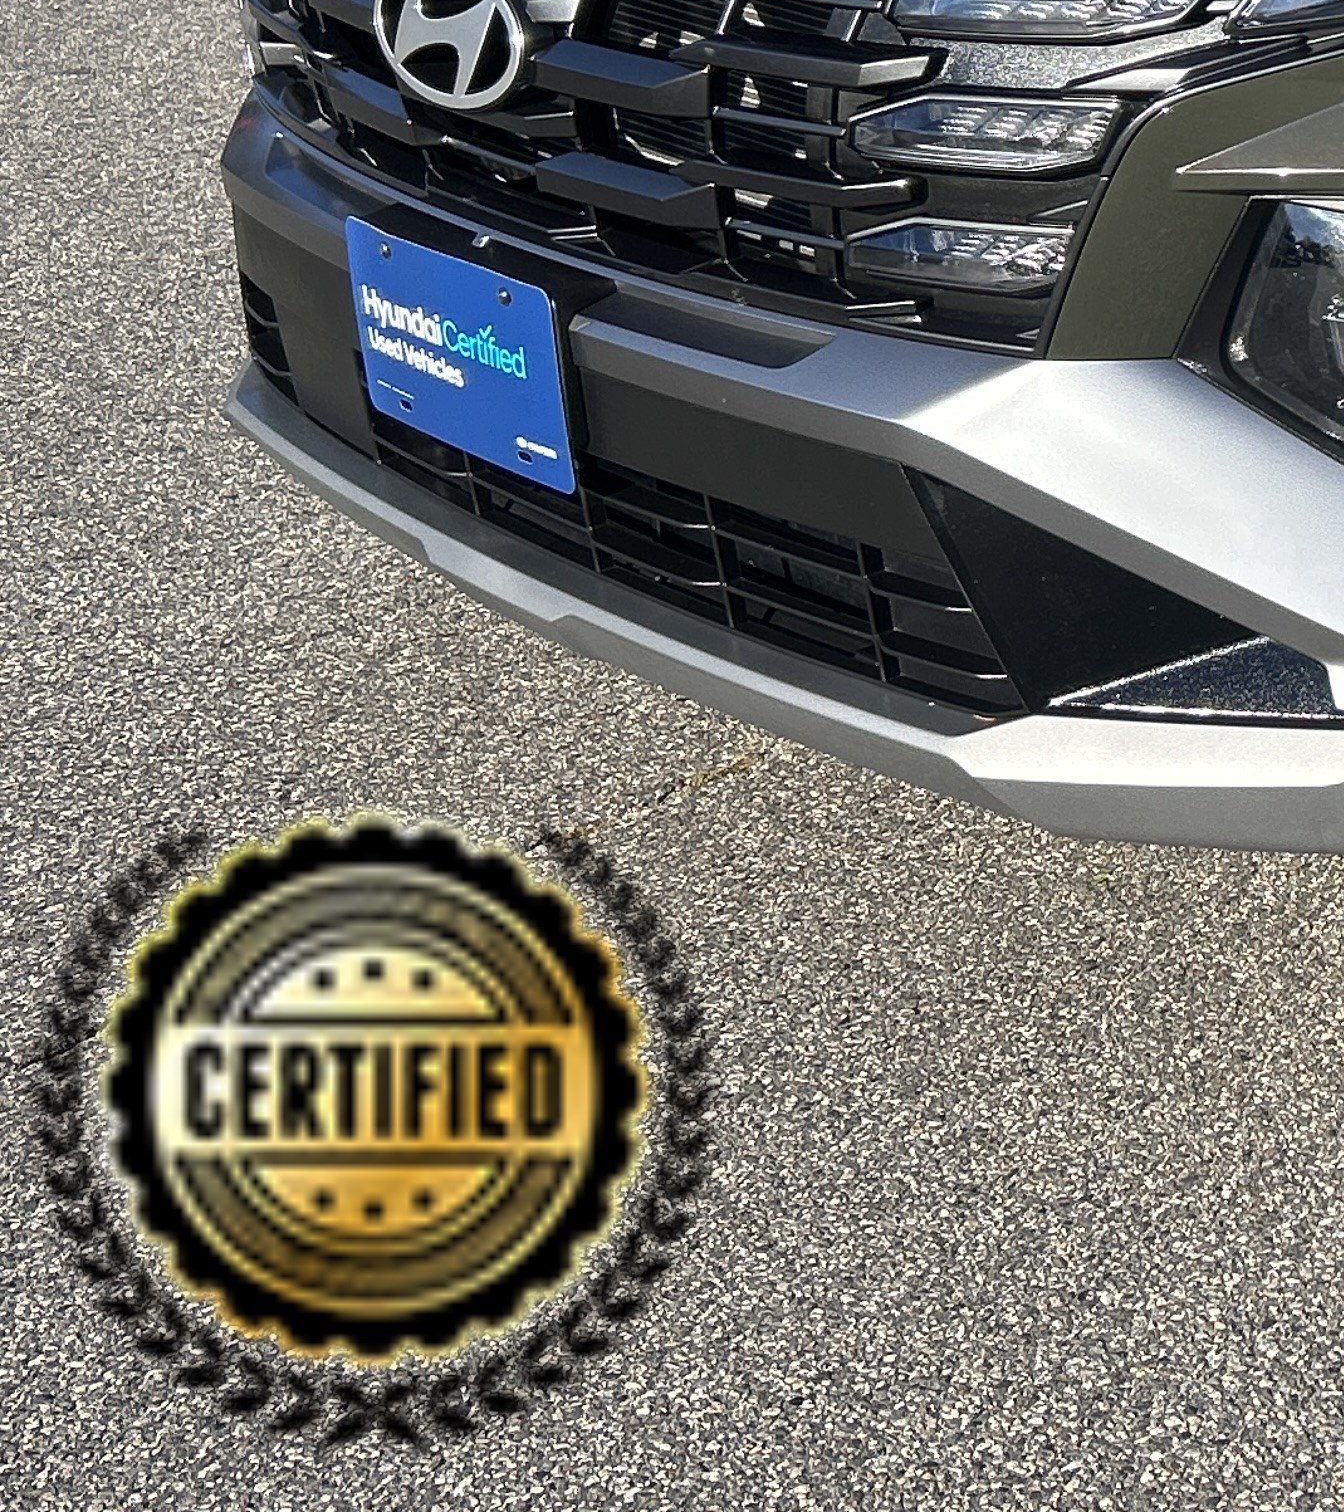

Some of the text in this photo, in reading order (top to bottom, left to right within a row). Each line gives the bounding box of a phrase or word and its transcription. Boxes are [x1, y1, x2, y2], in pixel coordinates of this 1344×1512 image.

[361, 284, 527, 379] Hyundai Certified
[367, 326, 465, 388] Used Vehicles
